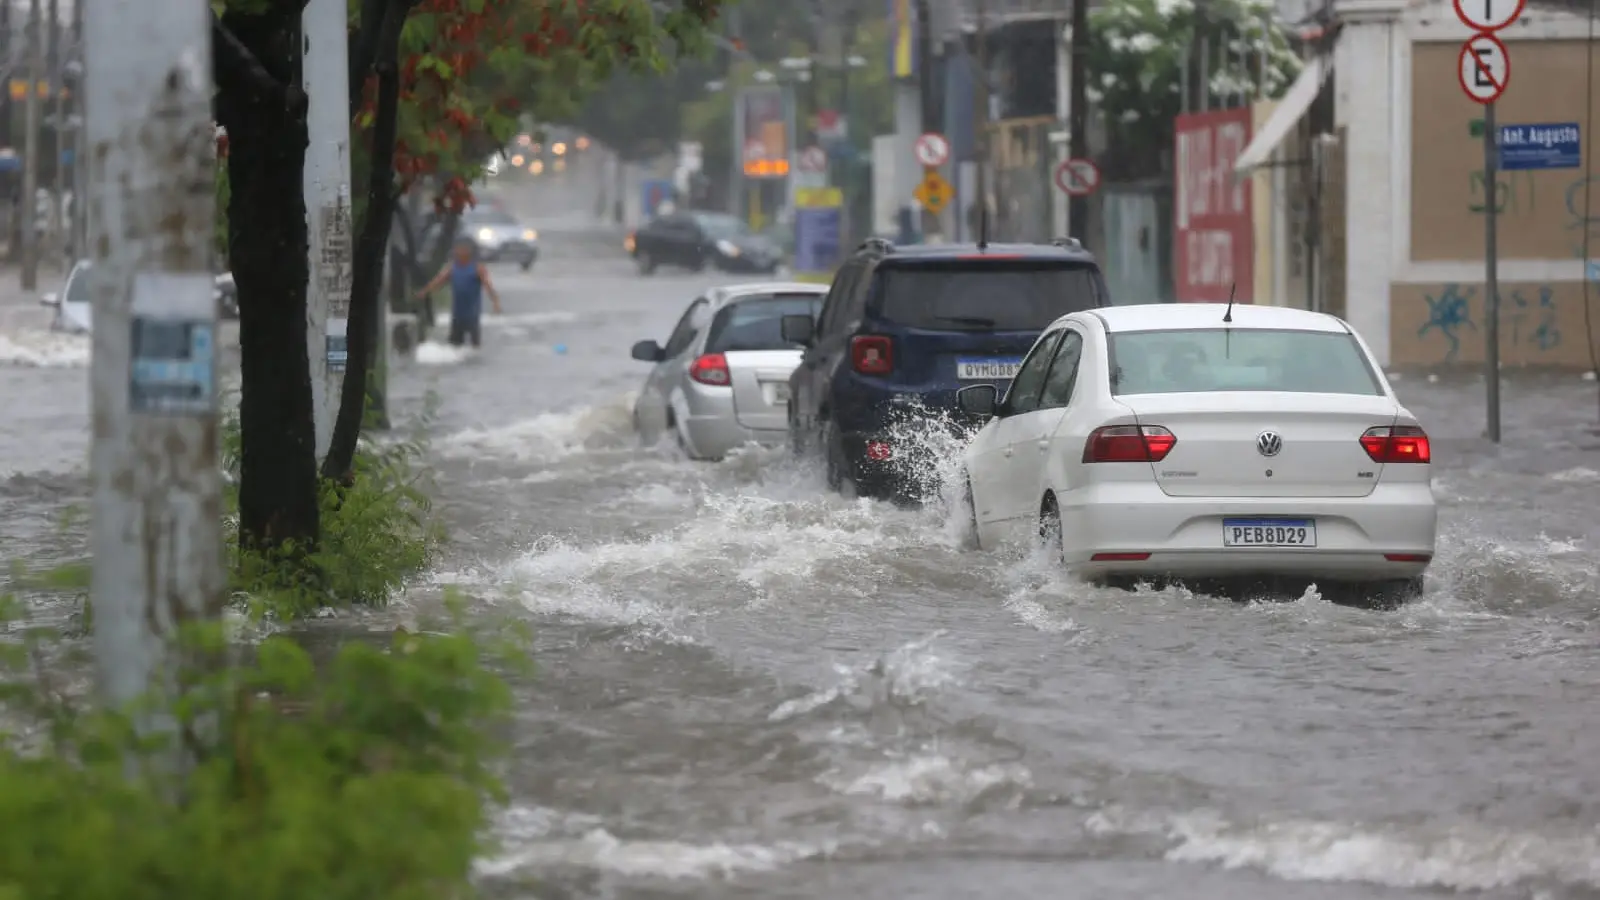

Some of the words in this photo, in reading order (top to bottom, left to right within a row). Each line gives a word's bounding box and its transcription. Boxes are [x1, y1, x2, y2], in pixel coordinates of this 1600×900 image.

[1475, 48, 1492, 87] E
[1503, 127, 1528, 145] Ant.
[1529, 126, 1577, 148] Augusto
[1232, 527, 1306, 543] PEB8D29
